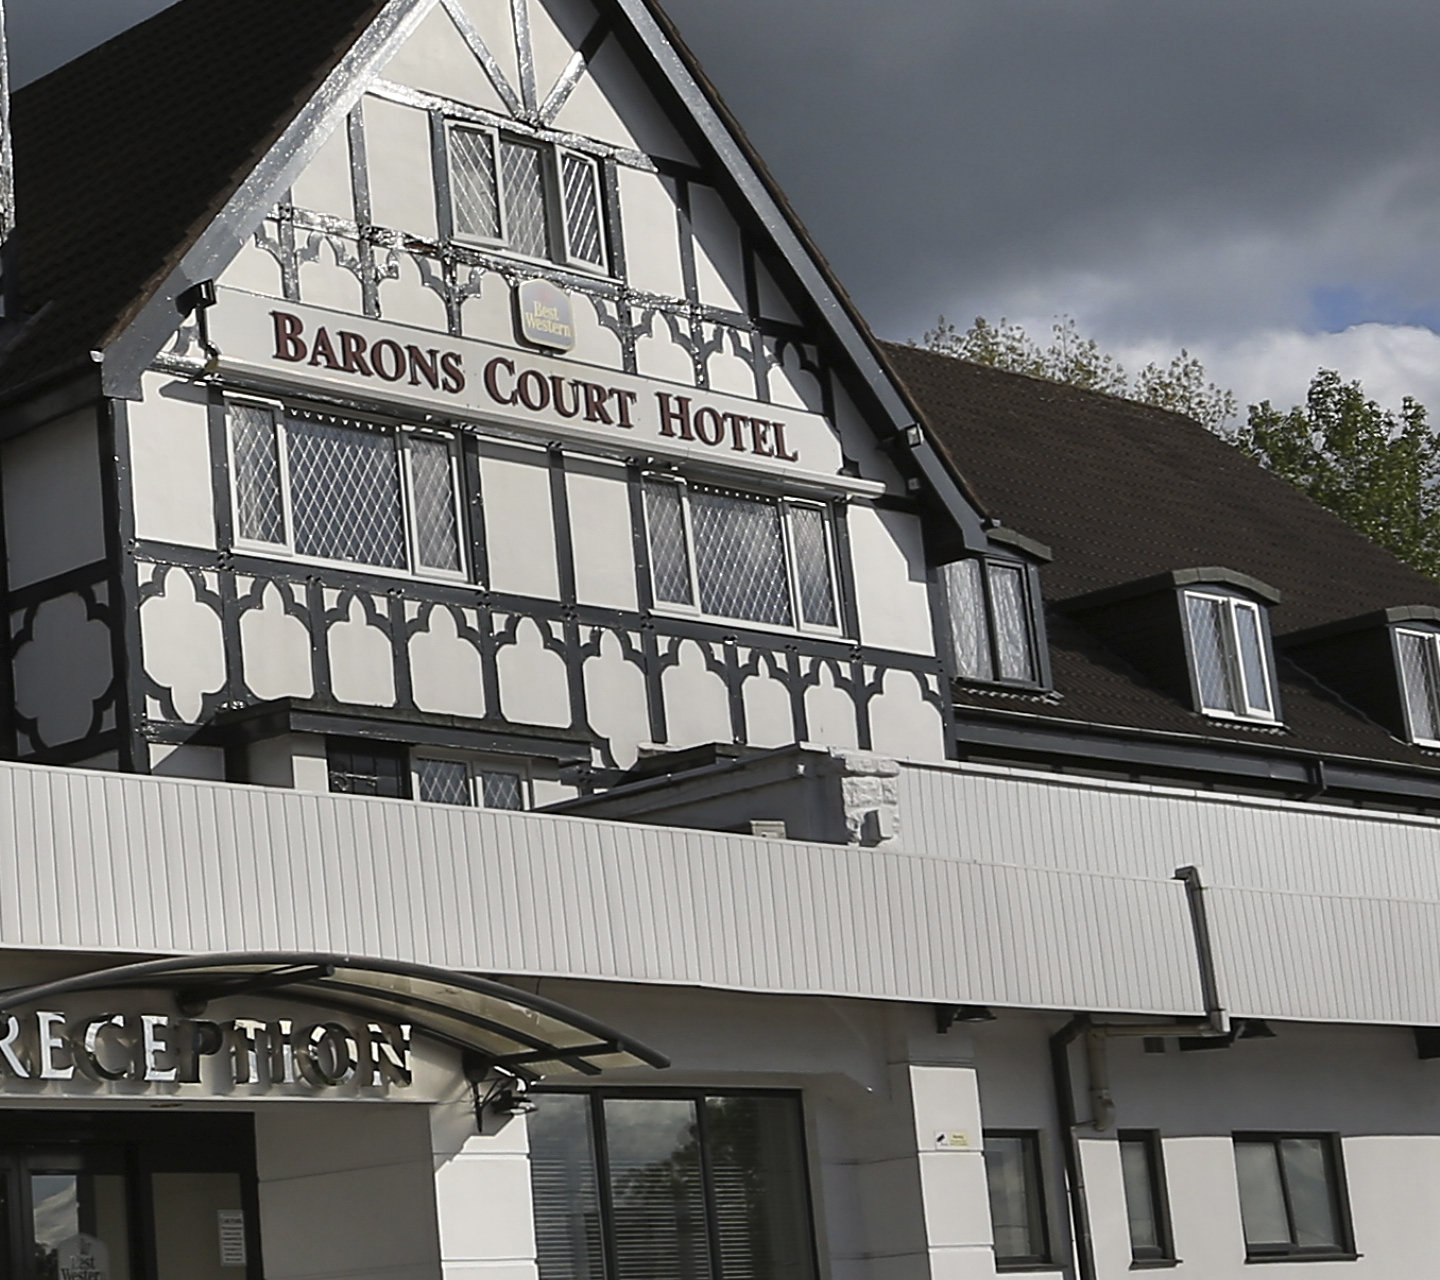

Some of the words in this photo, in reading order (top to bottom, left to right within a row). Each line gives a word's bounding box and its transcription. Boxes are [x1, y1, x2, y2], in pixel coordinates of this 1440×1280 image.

[533, 301, 560, 321] Best
[524, 312, 572, 337] Western
[270, 310, 466, 394] BARONS
[483, 356, 637, 430] COURT
[654, 391, 799, 463] HOTEL
